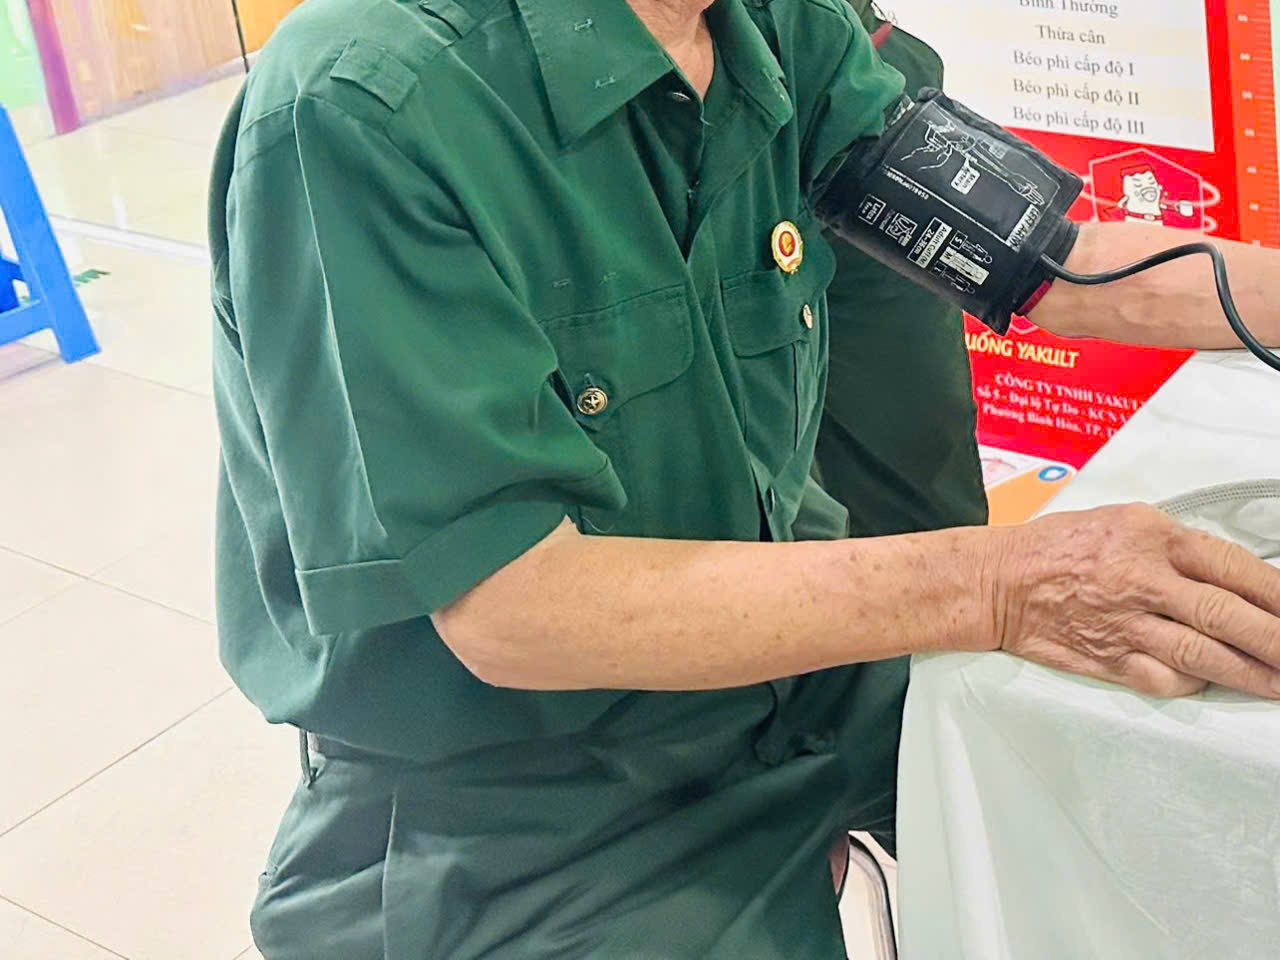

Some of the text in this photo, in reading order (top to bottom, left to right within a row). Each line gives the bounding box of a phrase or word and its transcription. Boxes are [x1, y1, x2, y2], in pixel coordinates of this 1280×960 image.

[1034, 24, 1105, 45] Thừa cân
[1013, 50, 1042, 66] Béo
[1046, 54, 1070, 71] phì
[1074, 54, 1100, 76] cấp
[1104, 60, 1124, 77] độ
[1013, 78, 1140, 106] Béo phì cấp độ II
[1013, 106, 1144, 135] Béo phì cấp độ III
[1016, 341, 1079, 369] YAKULT
[995, 372, 1034, 391] CÔNG
[1037, 381, 1053, 394] TY
[1055, 382, 1093, 403] TNHH
